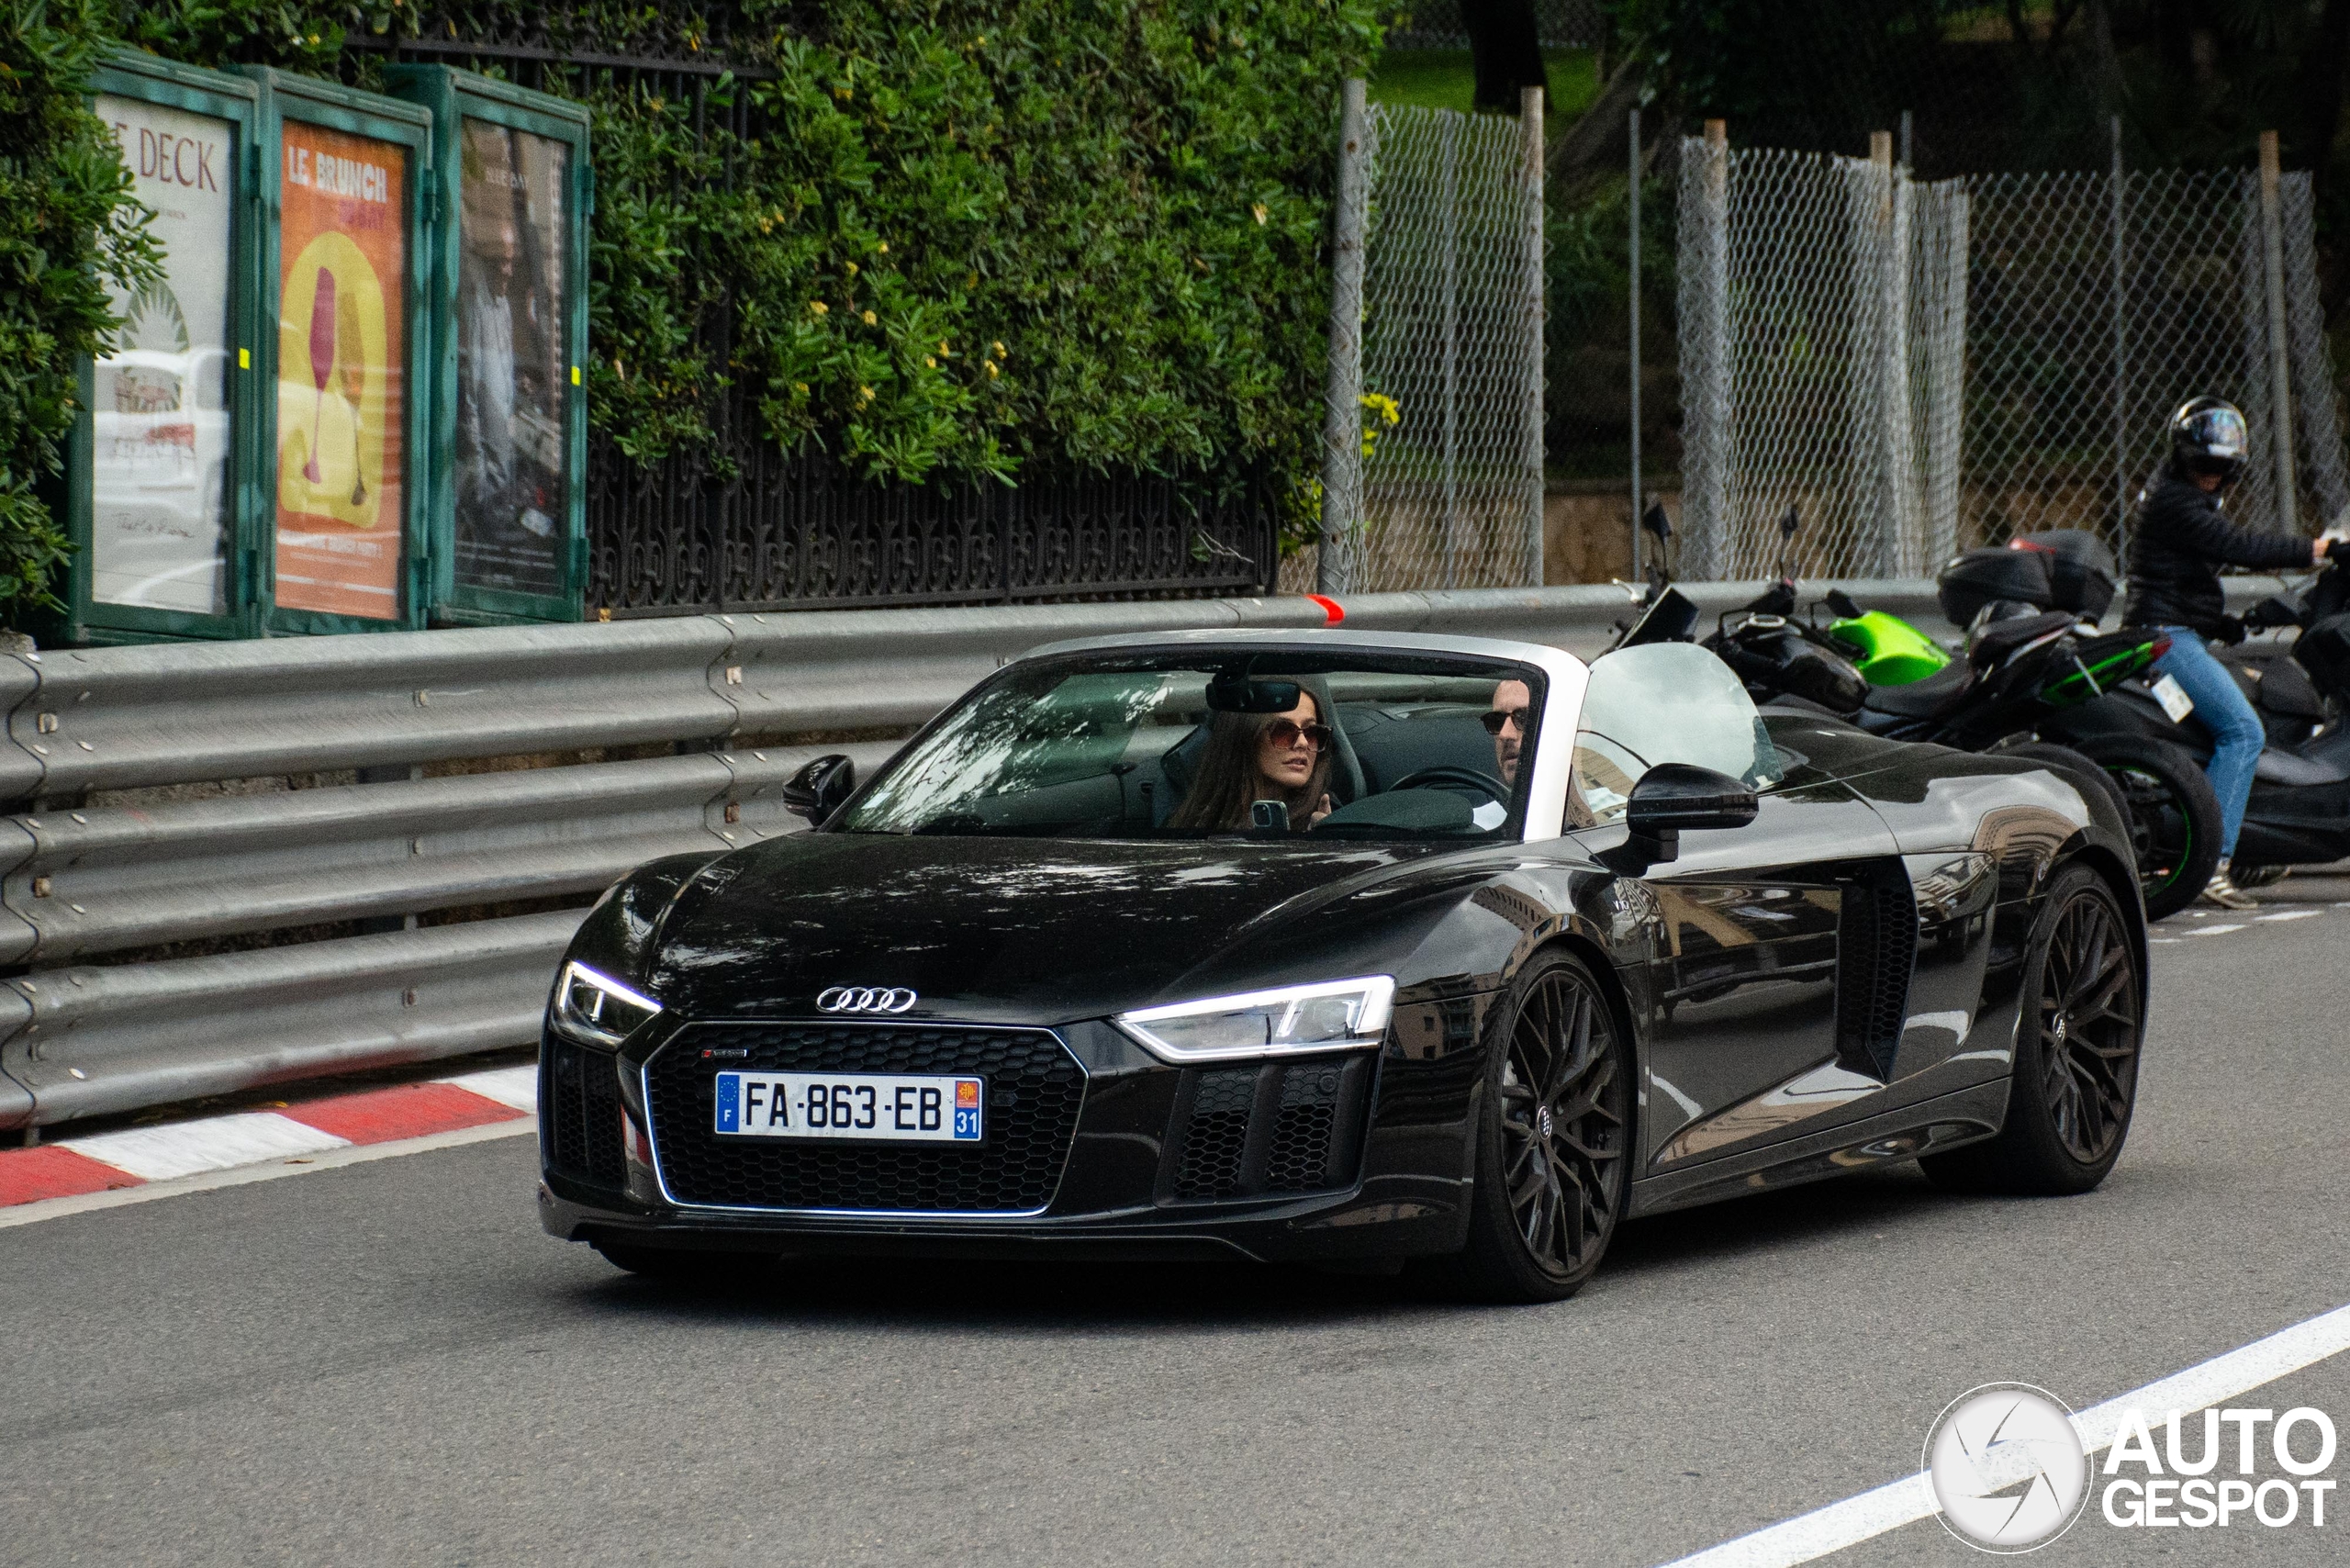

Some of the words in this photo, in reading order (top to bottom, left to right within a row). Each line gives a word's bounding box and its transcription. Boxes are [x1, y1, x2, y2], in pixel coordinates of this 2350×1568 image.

[140, 127, 218, 193] DECK
[287, 145, 309, 187] LE
[315, 151, 388, 204] BRUNCH
[1612, 900, 1629, 911] V10
[723, 1109, 732, 1123] F
[956, 1111, 978, 1134] 31
